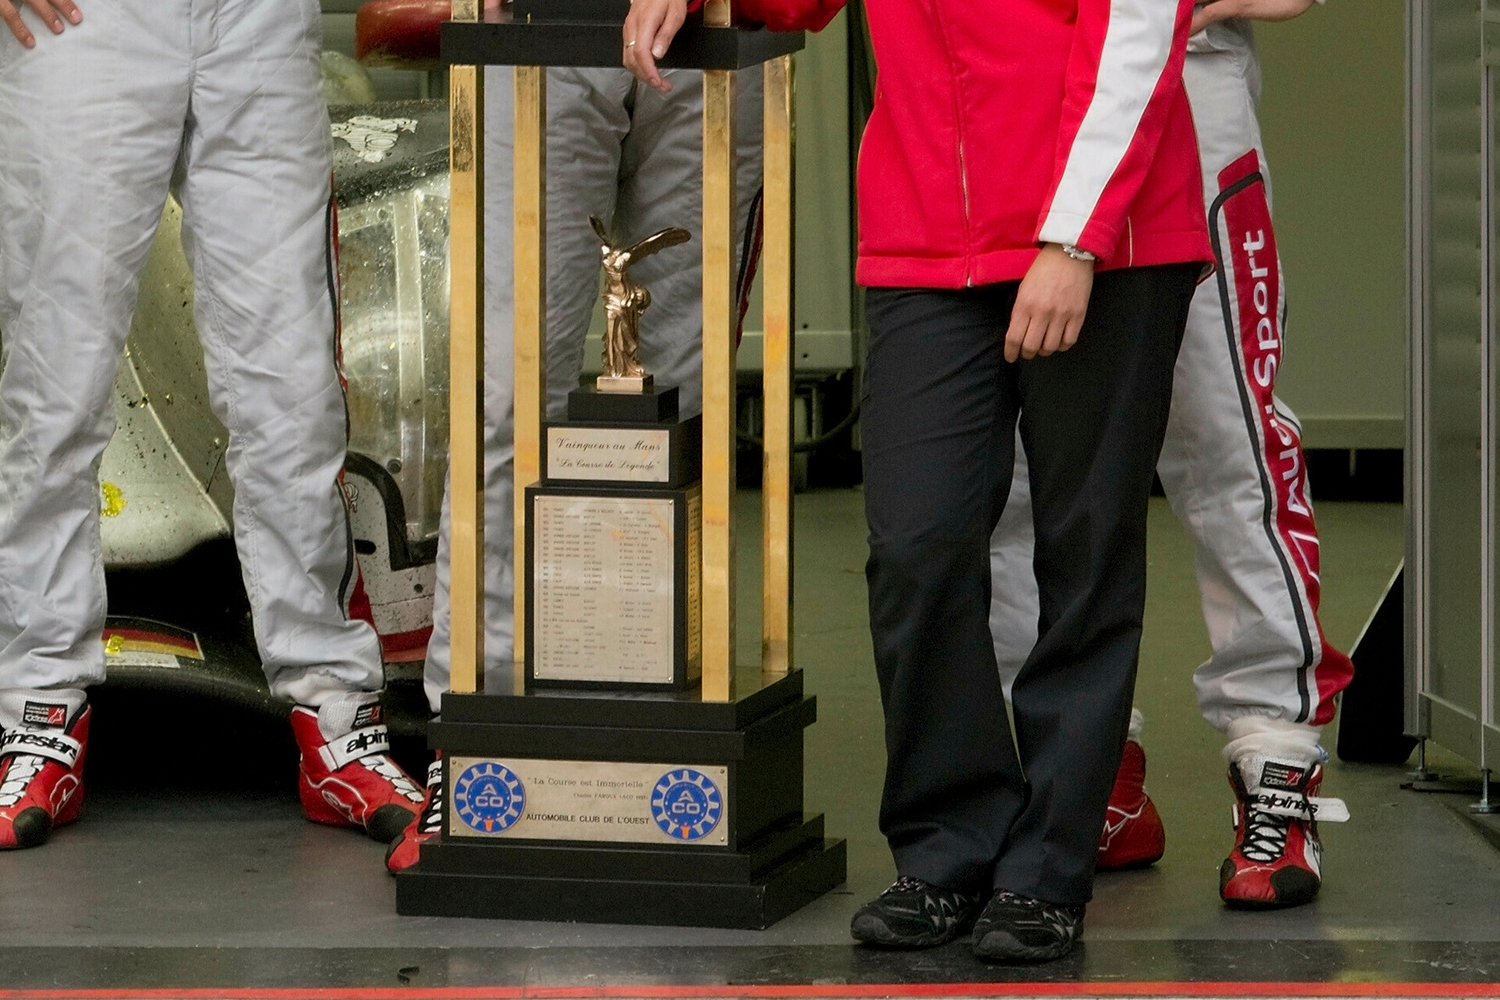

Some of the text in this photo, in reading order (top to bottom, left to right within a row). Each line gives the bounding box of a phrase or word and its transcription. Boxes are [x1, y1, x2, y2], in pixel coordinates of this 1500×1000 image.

[1242, 229, 1278, 388] Sport
[0, 730, 78, 761] pinestars
[526, 813, 650, 825] AUTOMOBILE CLUB DE L'OUEST
